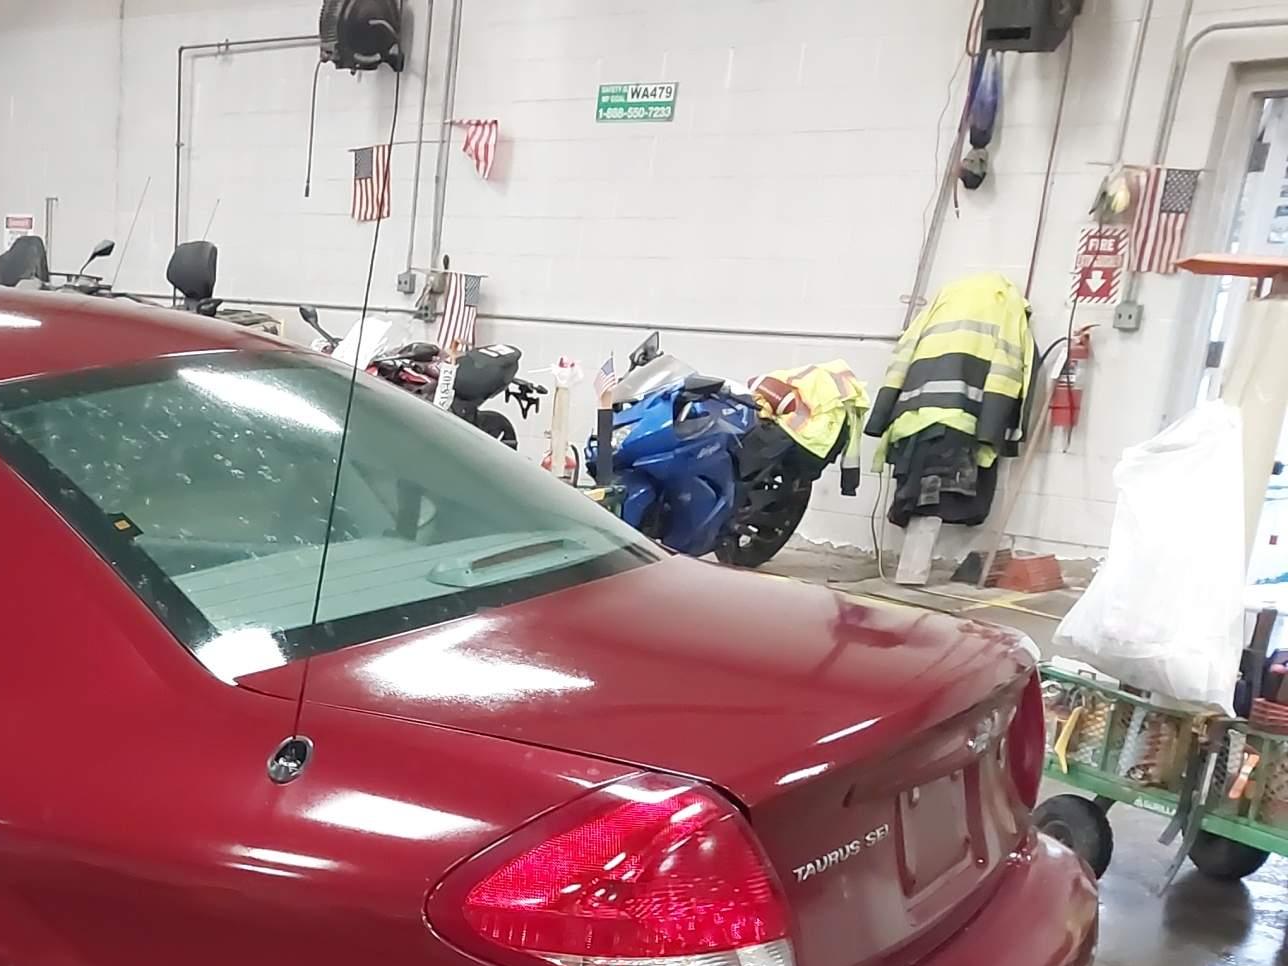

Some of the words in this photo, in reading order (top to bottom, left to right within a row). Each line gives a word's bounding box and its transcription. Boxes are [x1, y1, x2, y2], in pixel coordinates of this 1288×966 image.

[630, 86, 673, 99] WA479
[1087, 238, 1116, 251] FIRE
[792, 839, 861, 883] TAURUS
